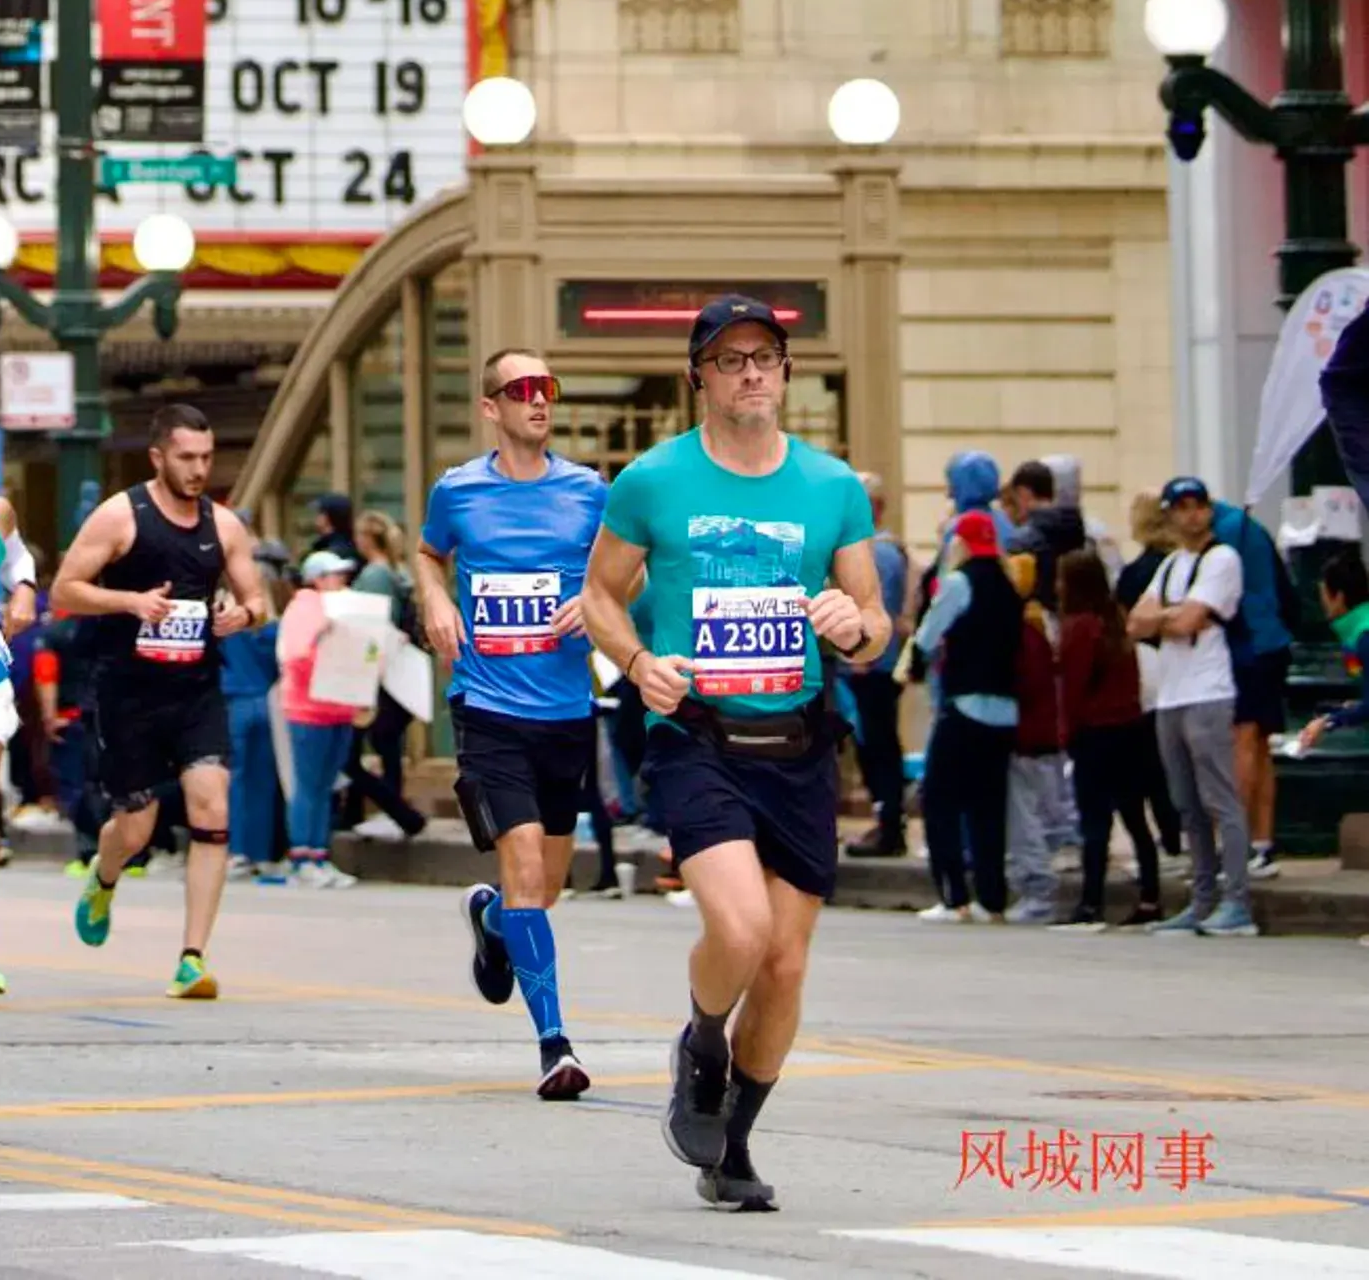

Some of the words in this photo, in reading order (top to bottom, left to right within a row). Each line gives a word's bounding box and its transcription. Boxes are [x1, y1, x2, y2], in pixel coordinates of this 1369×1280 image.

[233, 59, 339, 115] OCT
[376, 60, 425, 115] 19
[342, 151, 414, 204] 24
[474, 597, 490, 623] A
[497, 597, 557, 624] 1113
[138, 619, 154, 637] A
[159, 618, 205, 639] 6037
[695, 623, 716, 652] A
[723, 620, 803, 653] 23013
